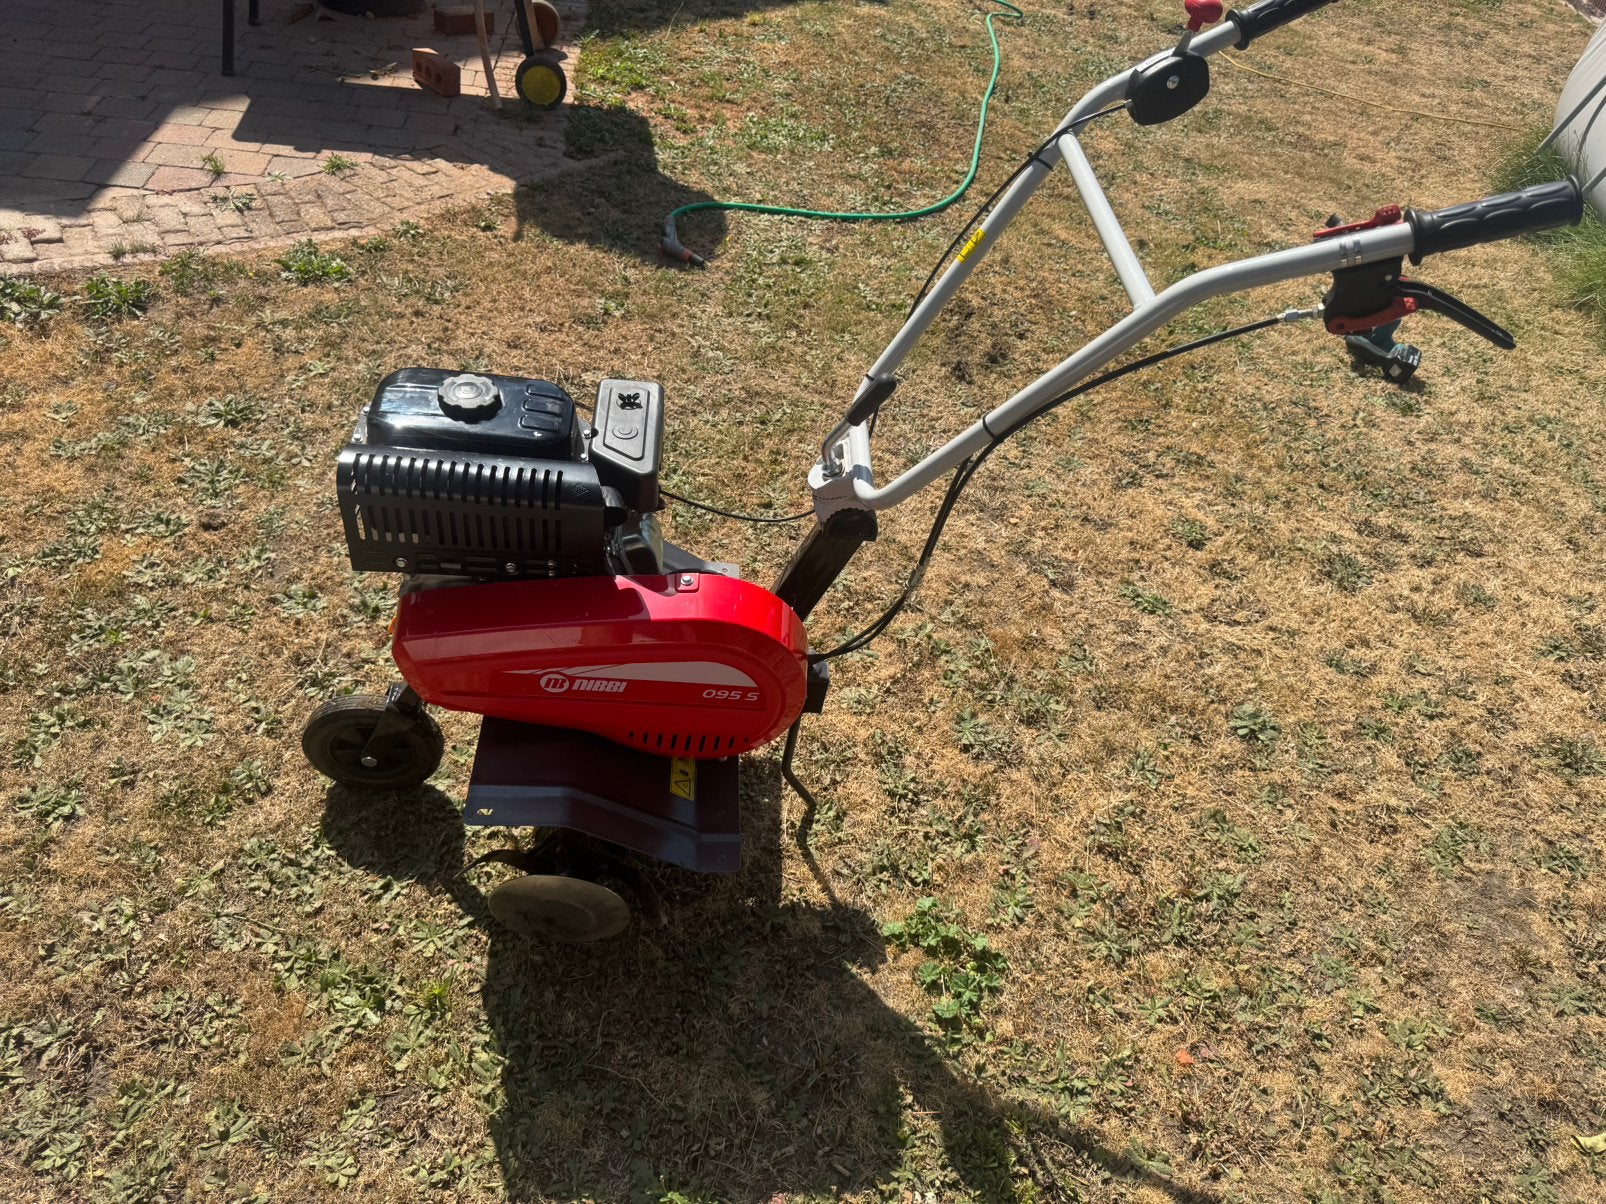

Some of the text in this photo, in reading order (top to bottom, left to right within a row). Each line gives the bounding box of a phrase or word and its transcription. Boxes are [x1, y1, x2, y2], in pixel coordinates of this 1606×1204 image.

[572, 679, 628, 693] NIBBI
[702, 689, 760, 701] 095 S
